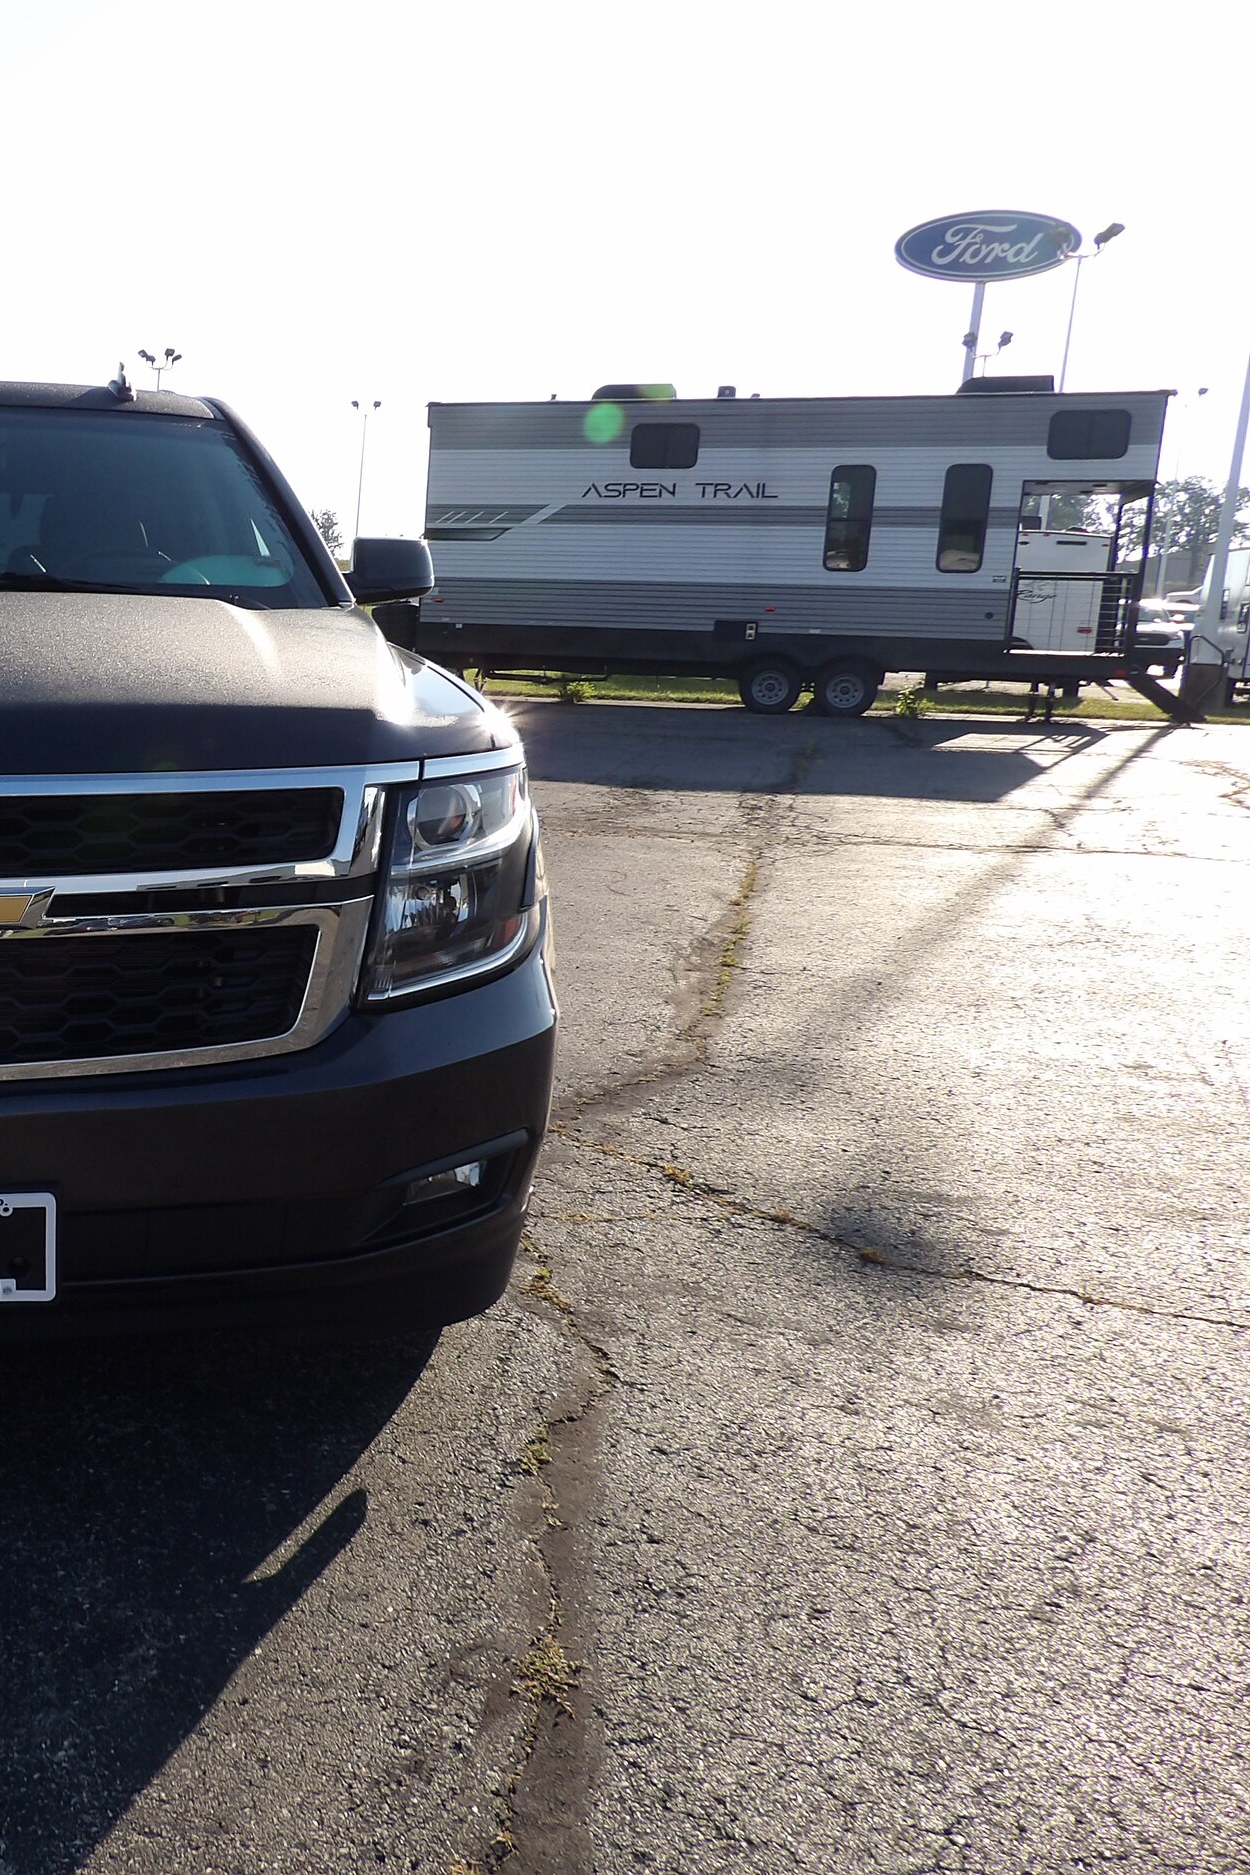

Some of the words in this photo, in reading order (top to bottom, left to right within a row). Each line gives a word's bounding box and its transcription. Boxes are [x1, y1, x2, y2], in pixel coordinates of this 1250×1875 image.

[931, 223, 1043, 265] Ford
[581, 482, 677, 498] ASPEN
[695, 482, 779, 498] TRAIL
